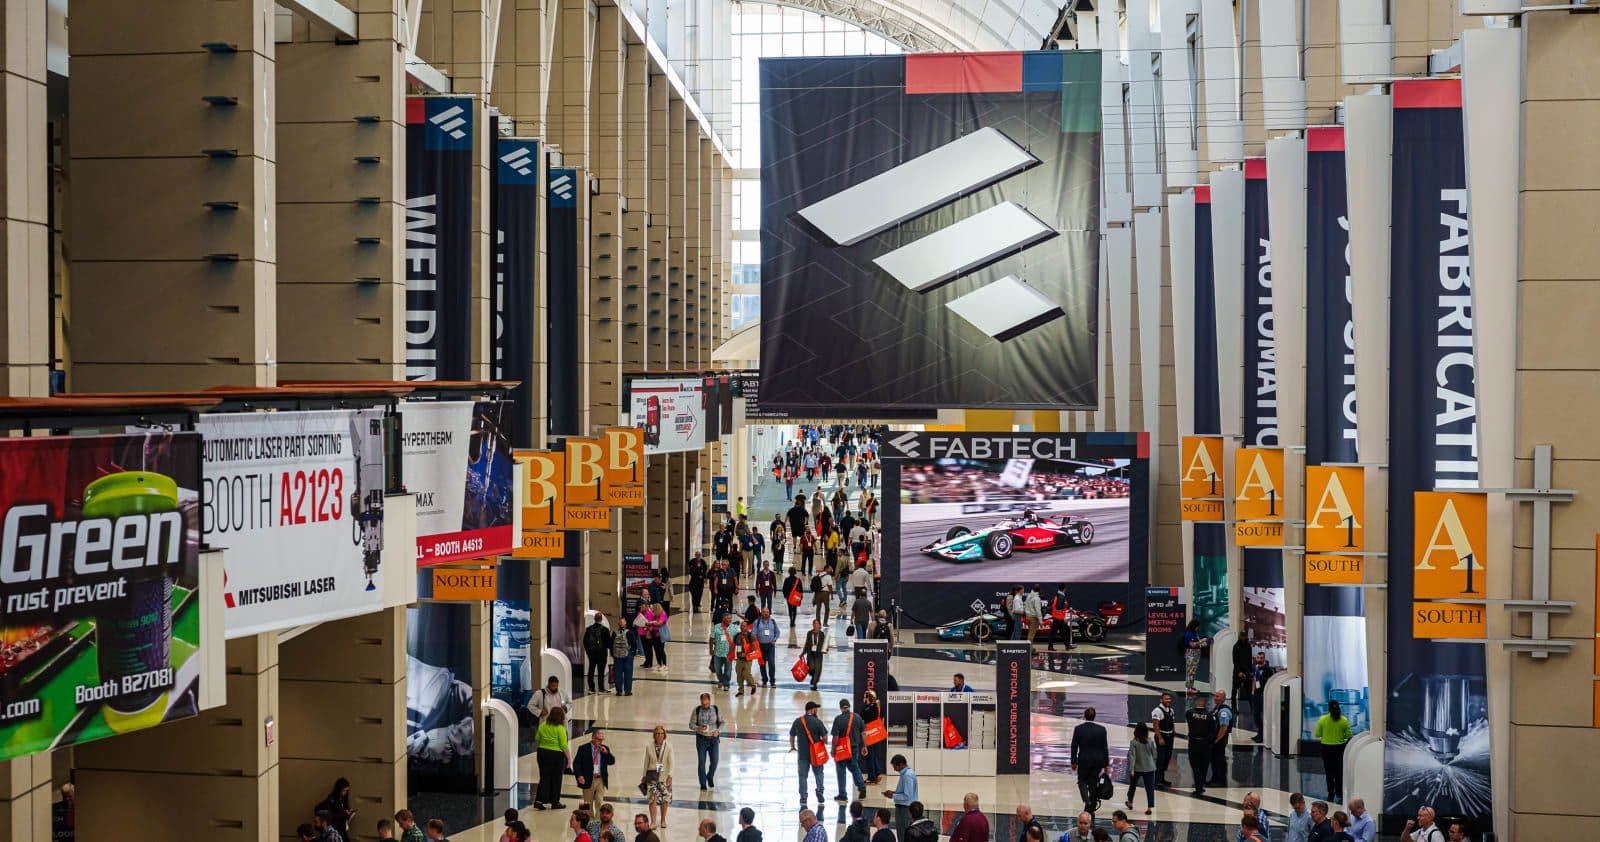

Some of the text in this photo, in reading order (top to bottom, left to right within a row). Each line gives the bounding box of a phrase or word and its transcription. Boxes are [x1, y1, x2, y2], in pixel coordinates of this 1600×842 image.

[203, 433, 342, 463] AUTOMATIC LASER PART SORTING
[402, 431, 452, 446] HYPERTHERM
[929, 437, 1076, 459] FABTECH
[203, 467, 343, 535] BOOTH A2123
[1183, 502, 1222, 514] SOUTH
[568, 510, 608, 520] NORTH
[522, 536, 561, 548] ORTH
[1238, 526, 1282, 538] SOUTH
[0, 504, 182, 584] Green
[434, 540, 460, 557] BOOTH
[462, 537, 483, 553] A4513
[1308, 559, 1361, 572] SOUTH
[436, 574, 492, 588] NORTH
[7, 576, 127, 614] rust prevent
[238, 577, 336, 606] MITSUBISHI LASER
[1418, 608, 1481, 624] SOUTH
[75, 668, 173, 704] Booth B27081
[1, 699, 40, 720] .com
[1010, 704, 1018, 764] PUBLICATIONS
